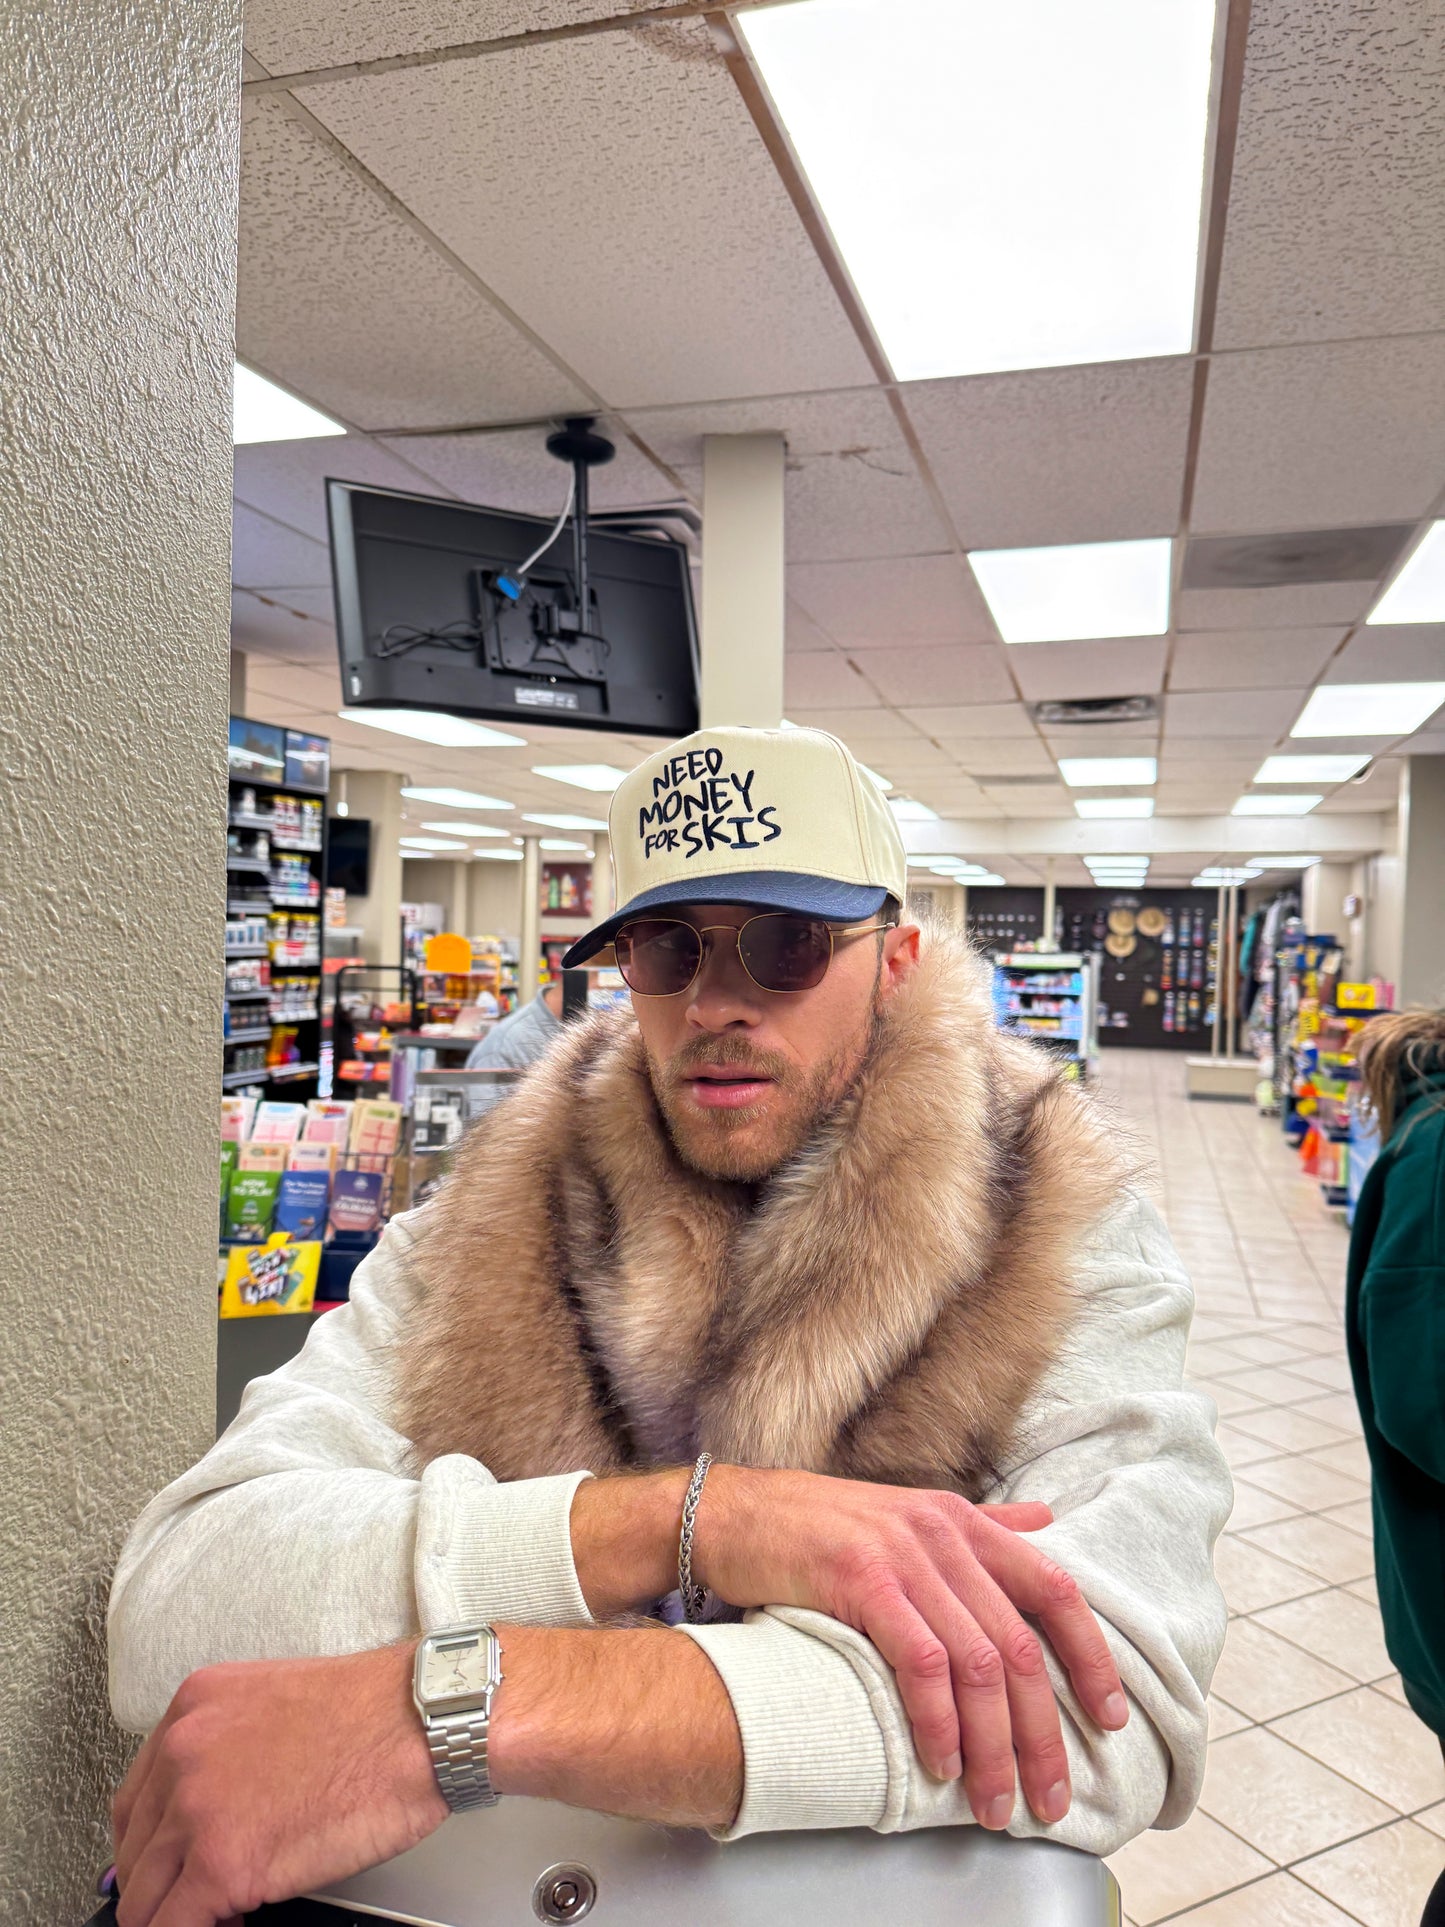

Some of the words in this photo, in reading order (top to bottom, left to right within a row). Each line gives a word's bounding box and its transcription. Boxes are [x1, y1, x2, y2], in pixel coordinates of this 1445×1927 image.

[653, 747, 723, 798] NEED
[639, 769, 755, 839] MONEY
[645, 828, 681, 859] FOR
[682, 806, 782, 859] SKIS
